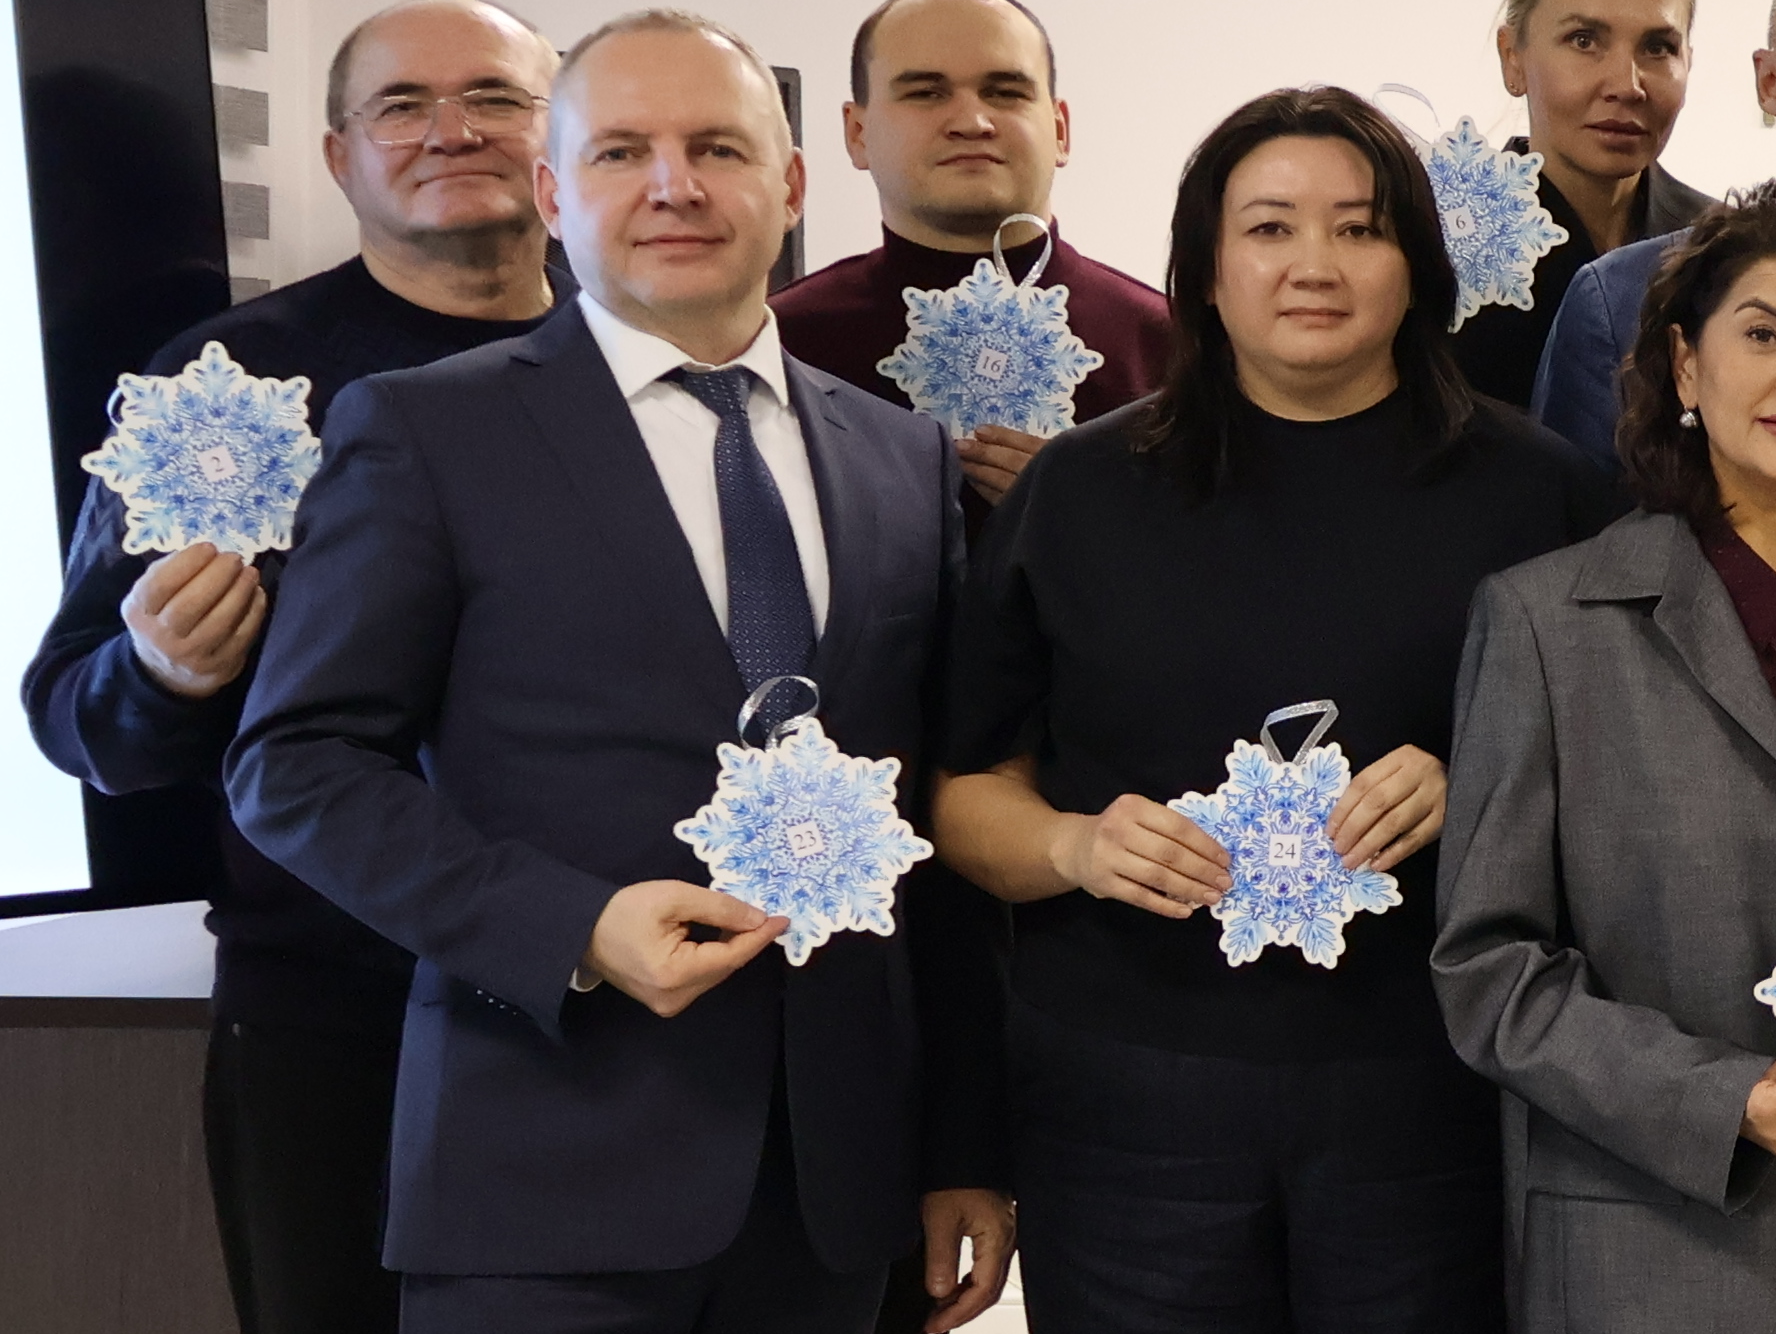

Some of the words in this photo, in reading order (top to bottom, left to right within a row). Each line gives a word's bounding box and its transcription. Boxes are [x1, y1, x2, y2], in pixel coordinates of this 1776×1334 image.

[1456, 214, 1466, 230] 6
[982, 355, 1001, 373] 16
[210, 456, 224, 472] 2
[793, 830, 817, 850] 23
[1273, 842, 1296, 859] 24
